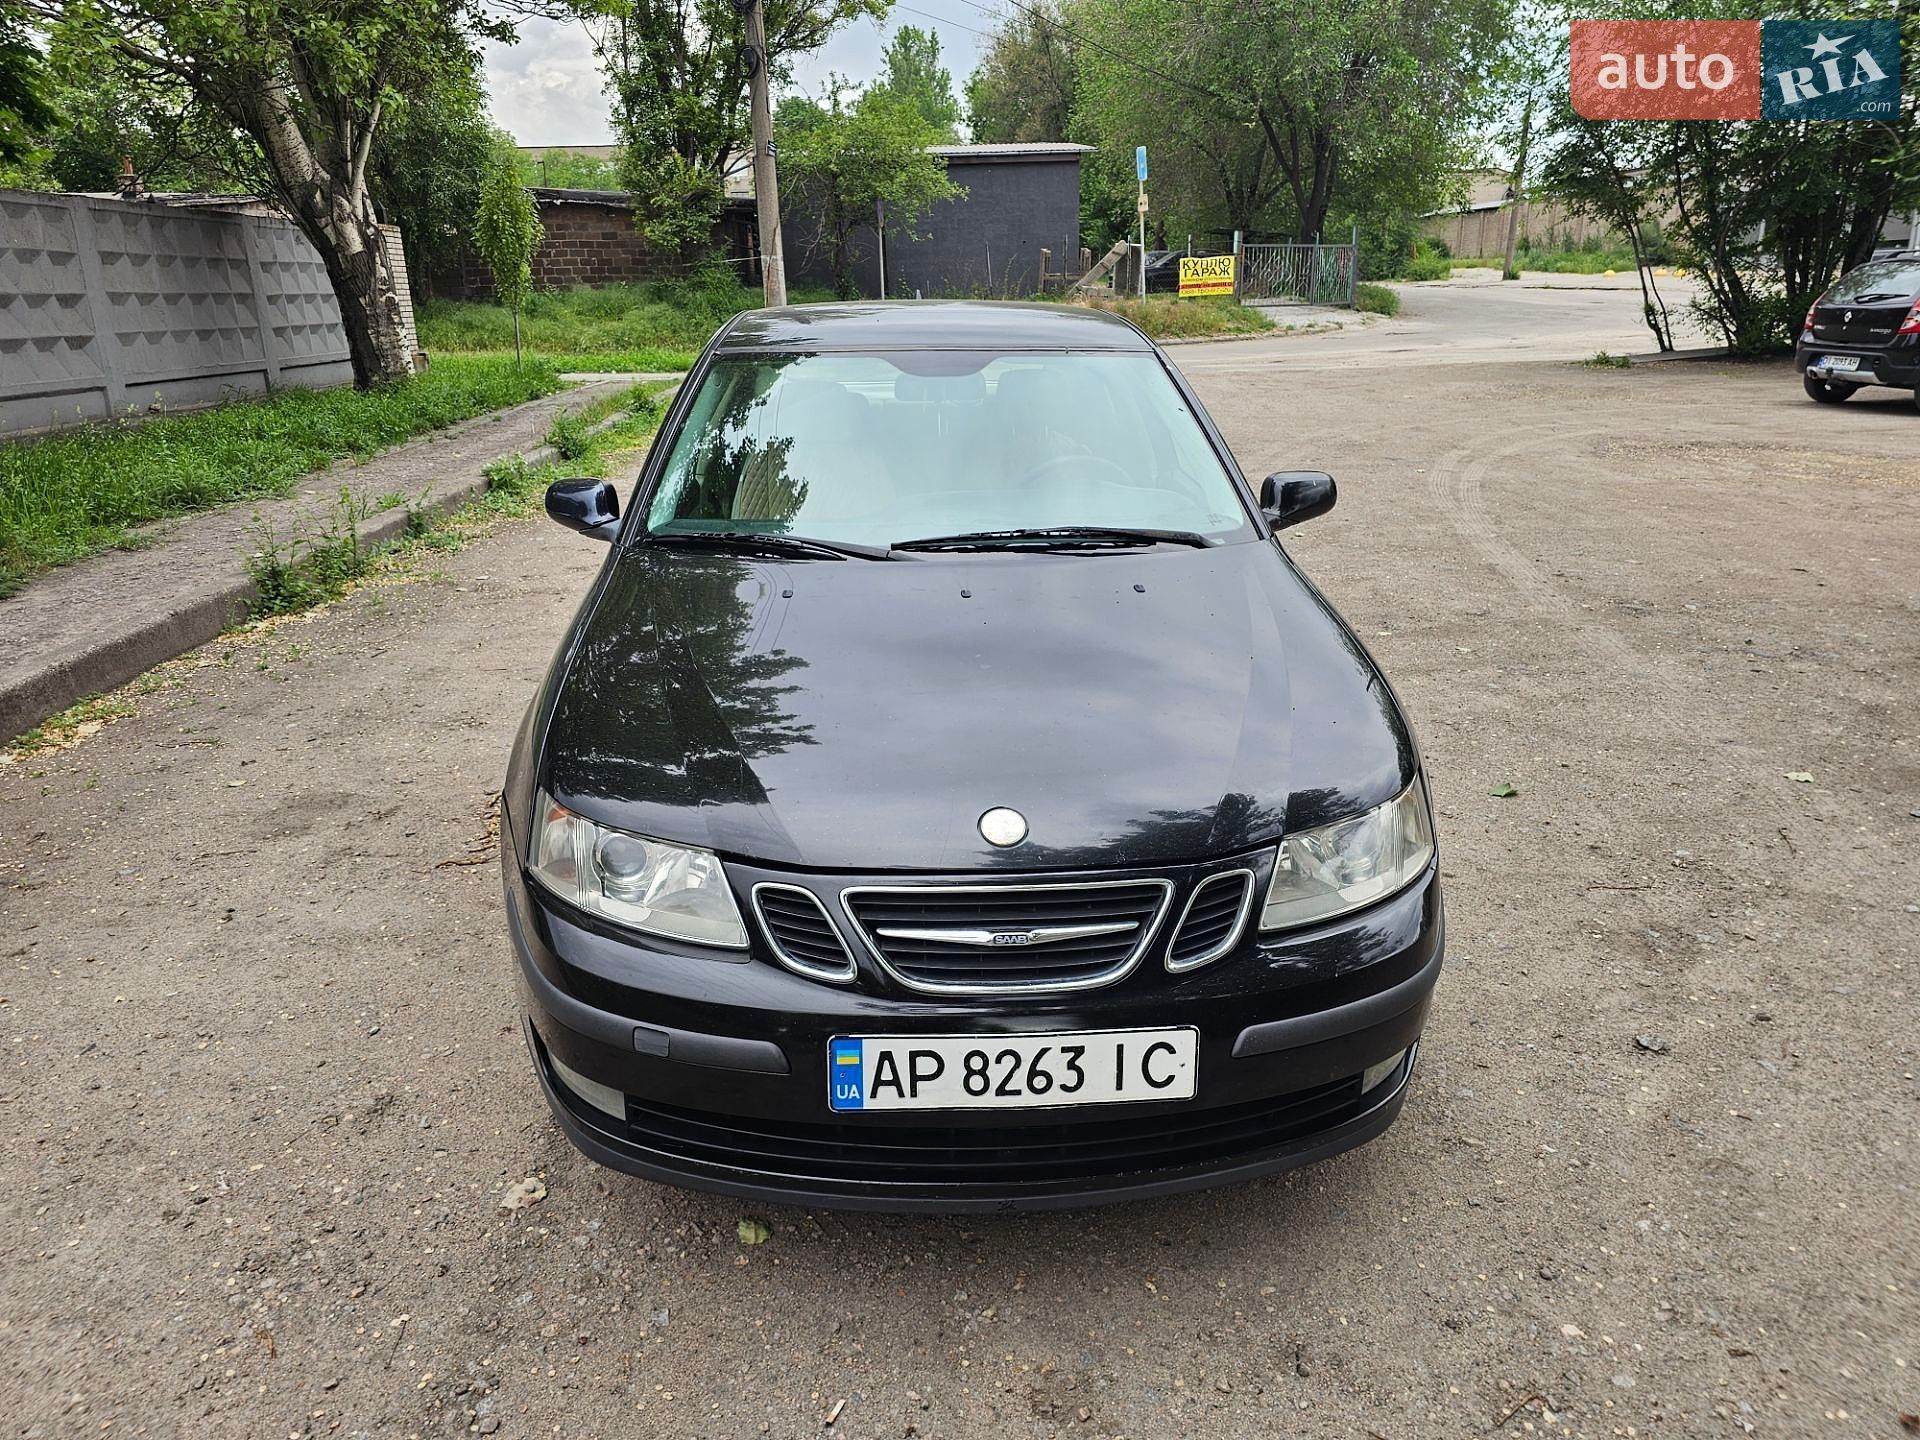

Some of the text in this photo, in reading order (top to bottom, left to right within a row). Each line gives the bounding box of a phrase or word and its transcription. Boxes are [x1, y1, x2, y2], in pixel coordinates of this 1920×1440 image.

[1183, 258, 1230, 269] КУПЛЮ
[1184, 267, 1230, 277] ГАРАЖ
[995, 935, 1027, 945] SAAB
[869, 1049, 945, 1099] AP
[962, 1045, 1085, 1097] 8263
[836, 1083, 860, 1100] UA
